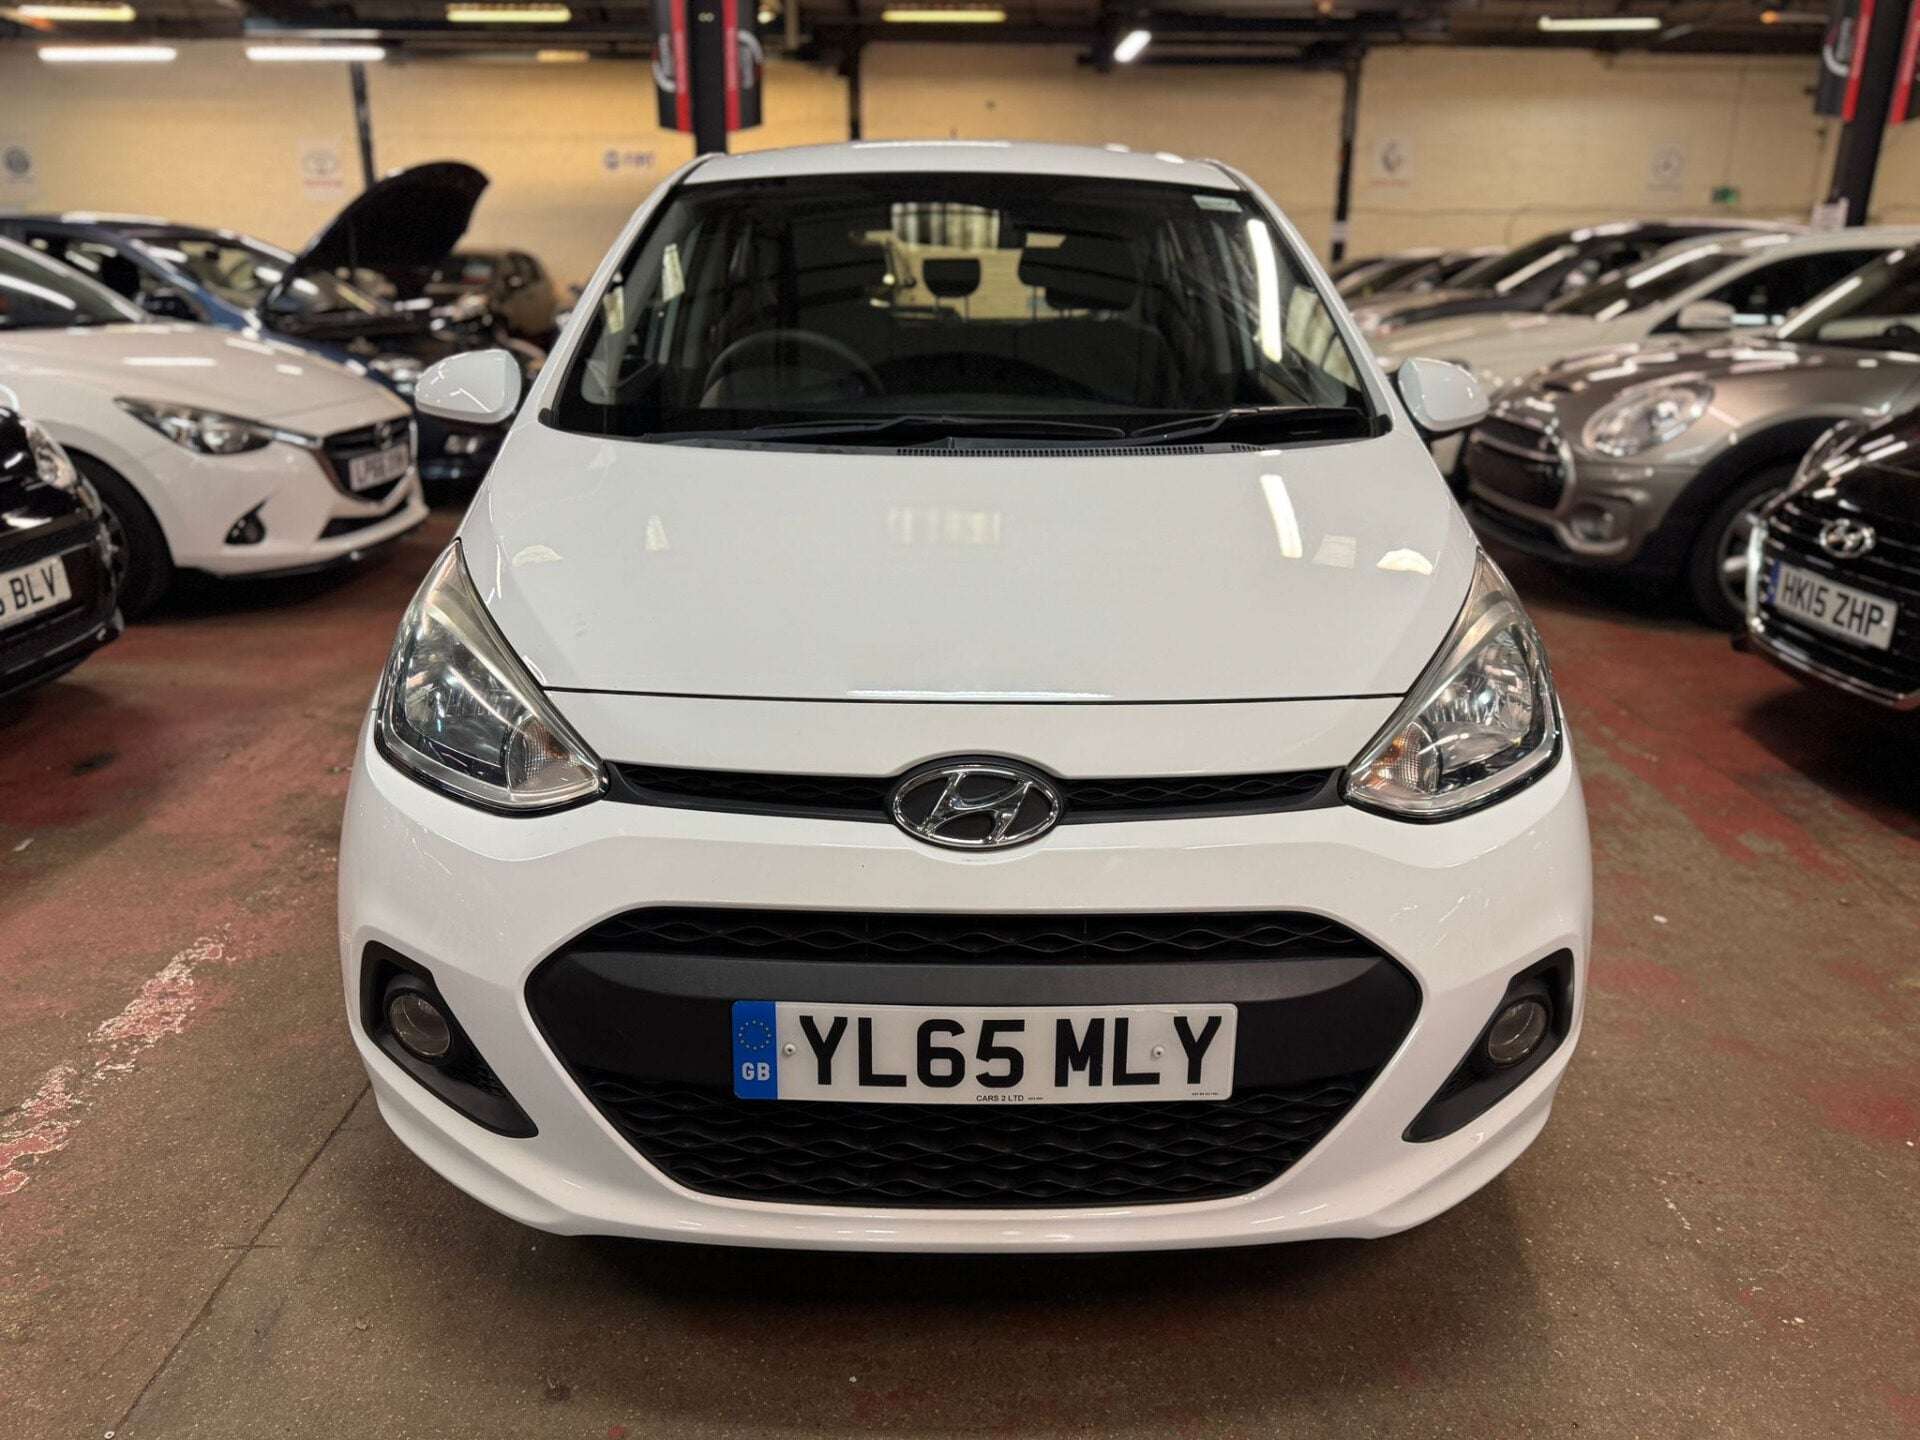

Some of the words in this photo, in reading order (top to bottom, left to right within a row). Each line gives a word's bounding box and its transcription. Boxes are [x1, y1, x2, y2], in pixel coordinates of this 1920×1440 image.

[9, 566, 55, 610] BLV
[1832, 592, 1885, 637] ZHP
[741, 1062, 770, 1081] GB
[799, 1015, 1025, 1089] YL65
[1054, 1015, 1222, 1087] MLY
